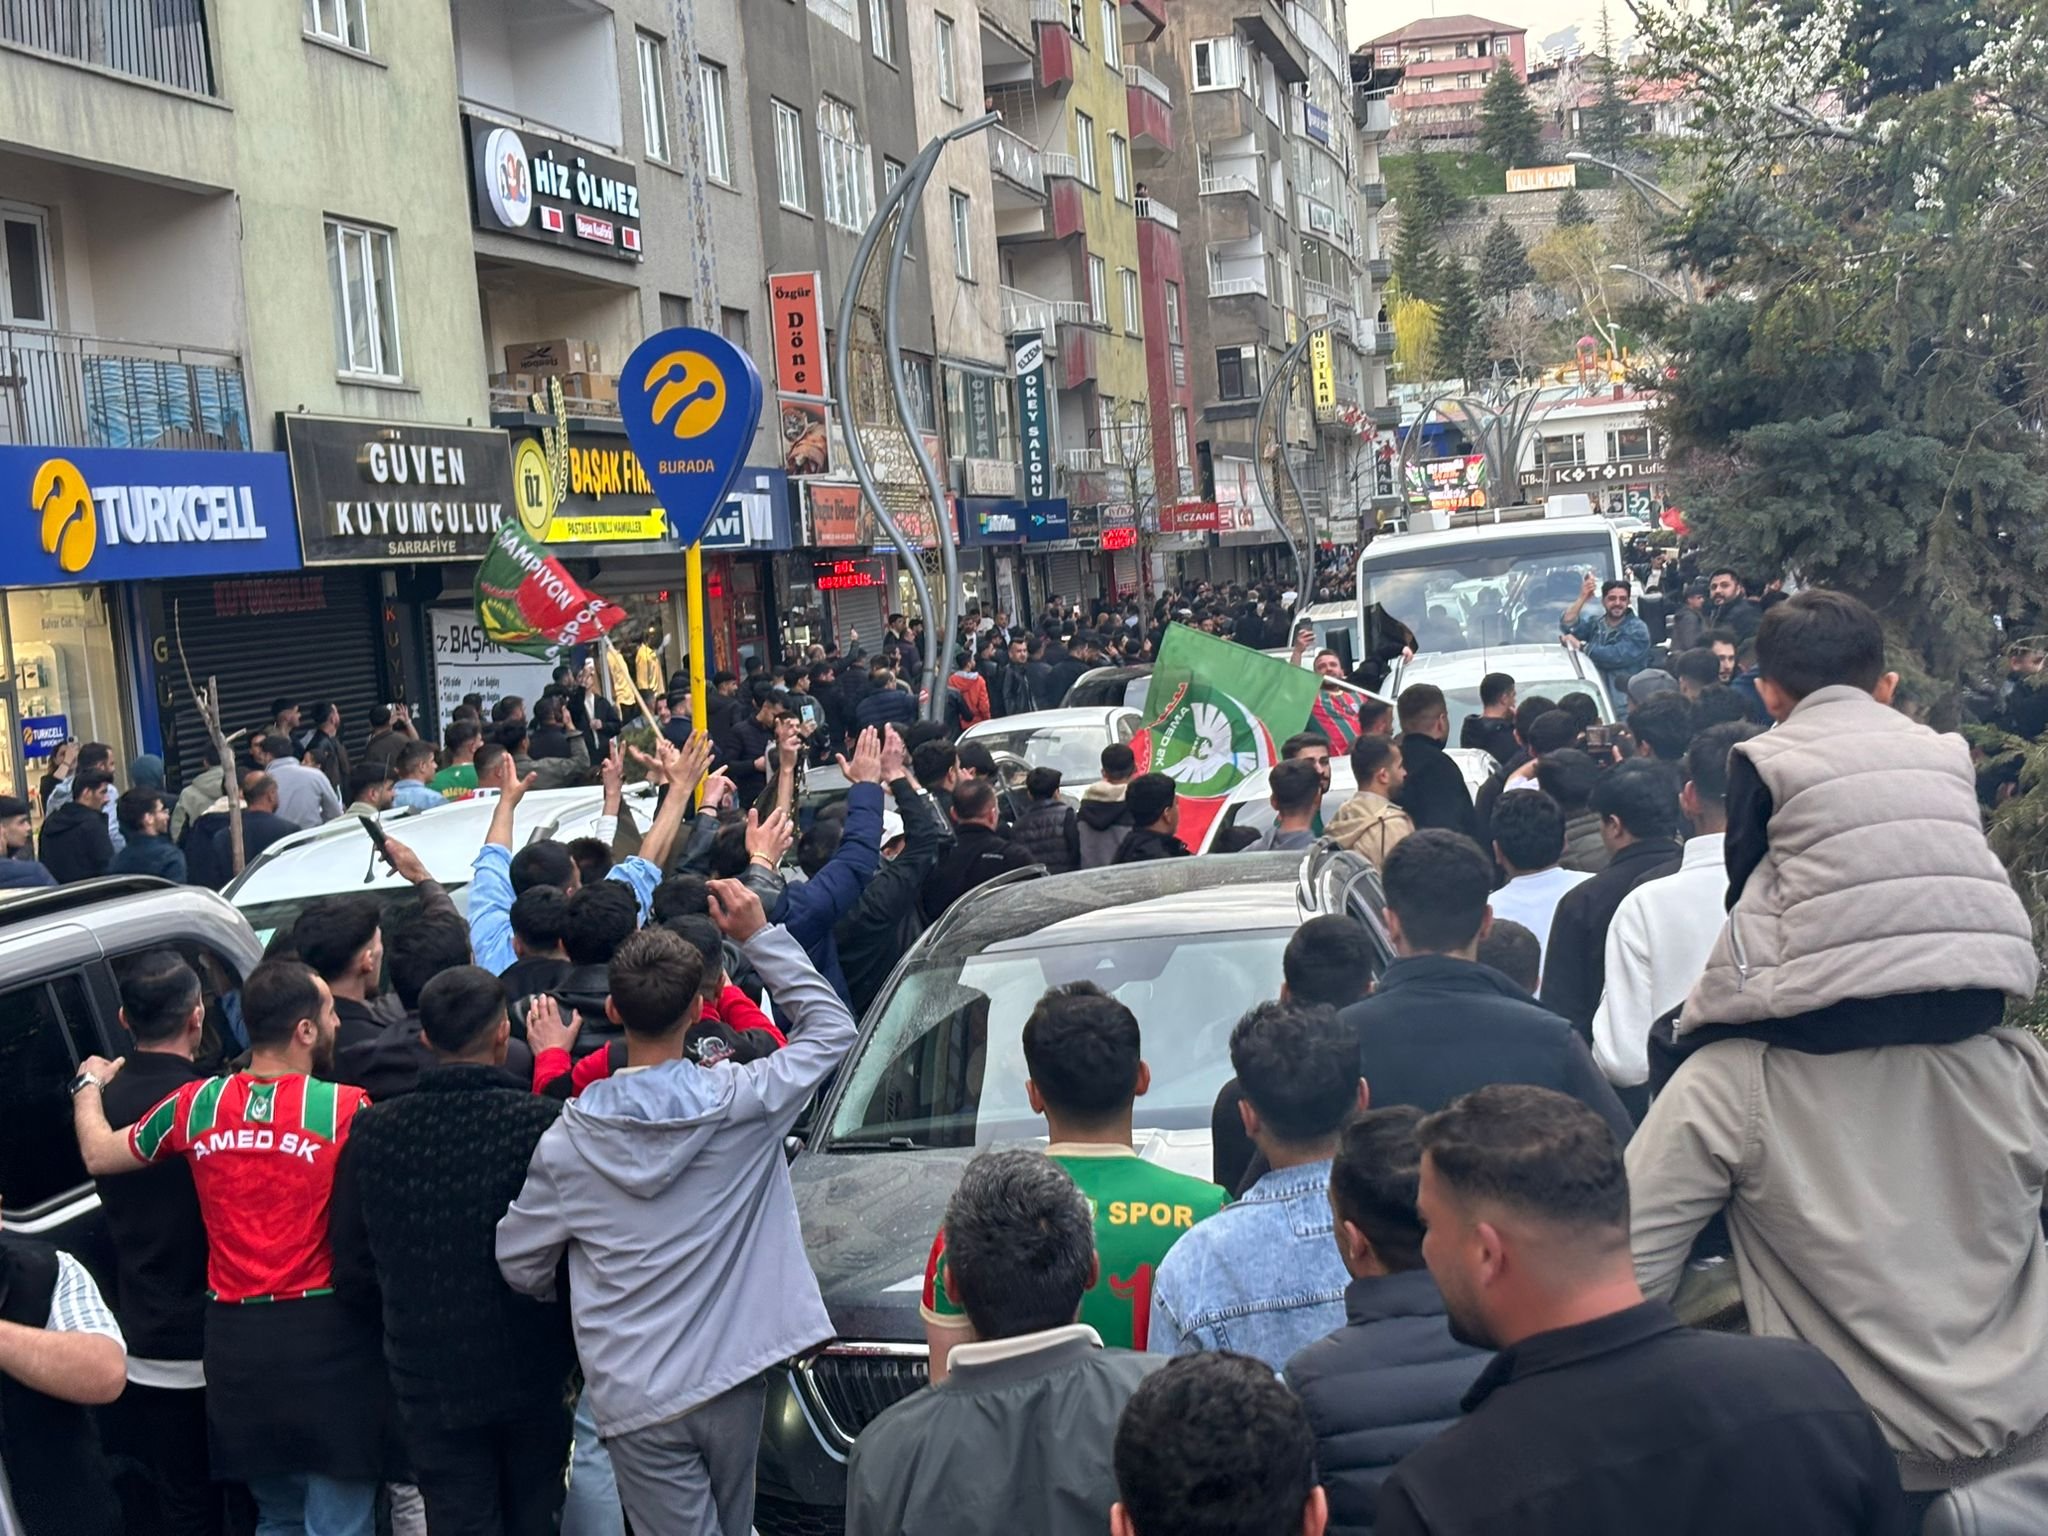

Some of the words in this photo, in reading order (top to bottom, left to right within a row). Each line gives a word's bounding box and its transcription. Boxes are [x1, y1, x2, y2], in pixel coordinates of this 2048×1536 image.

[577, 157, 640, 218] ÖLMEZ
[775, 287, 811, 300] Özgür
[1025, 375, 1039, 422] OKEY
[369, 429, 466, 485] GÜVEN
[659, 459, 715, 474] BURADA
[1028, 426, 1043, 497] SALONU
[525, 468, 543, 508] ÖZ
[569, 447, 622, 502] BAŞAK
[92, 485, 267, 545] TURKCELL
[335, 501, 503, 535] KUYUMCULUK
[388, 536, 457, 555] SARRAFİYE
[193, 1129, 273, 1161] AMED
[279, 1132, 322, 1163] SK
[1108, 1201, 1194, 1228] SPOR
